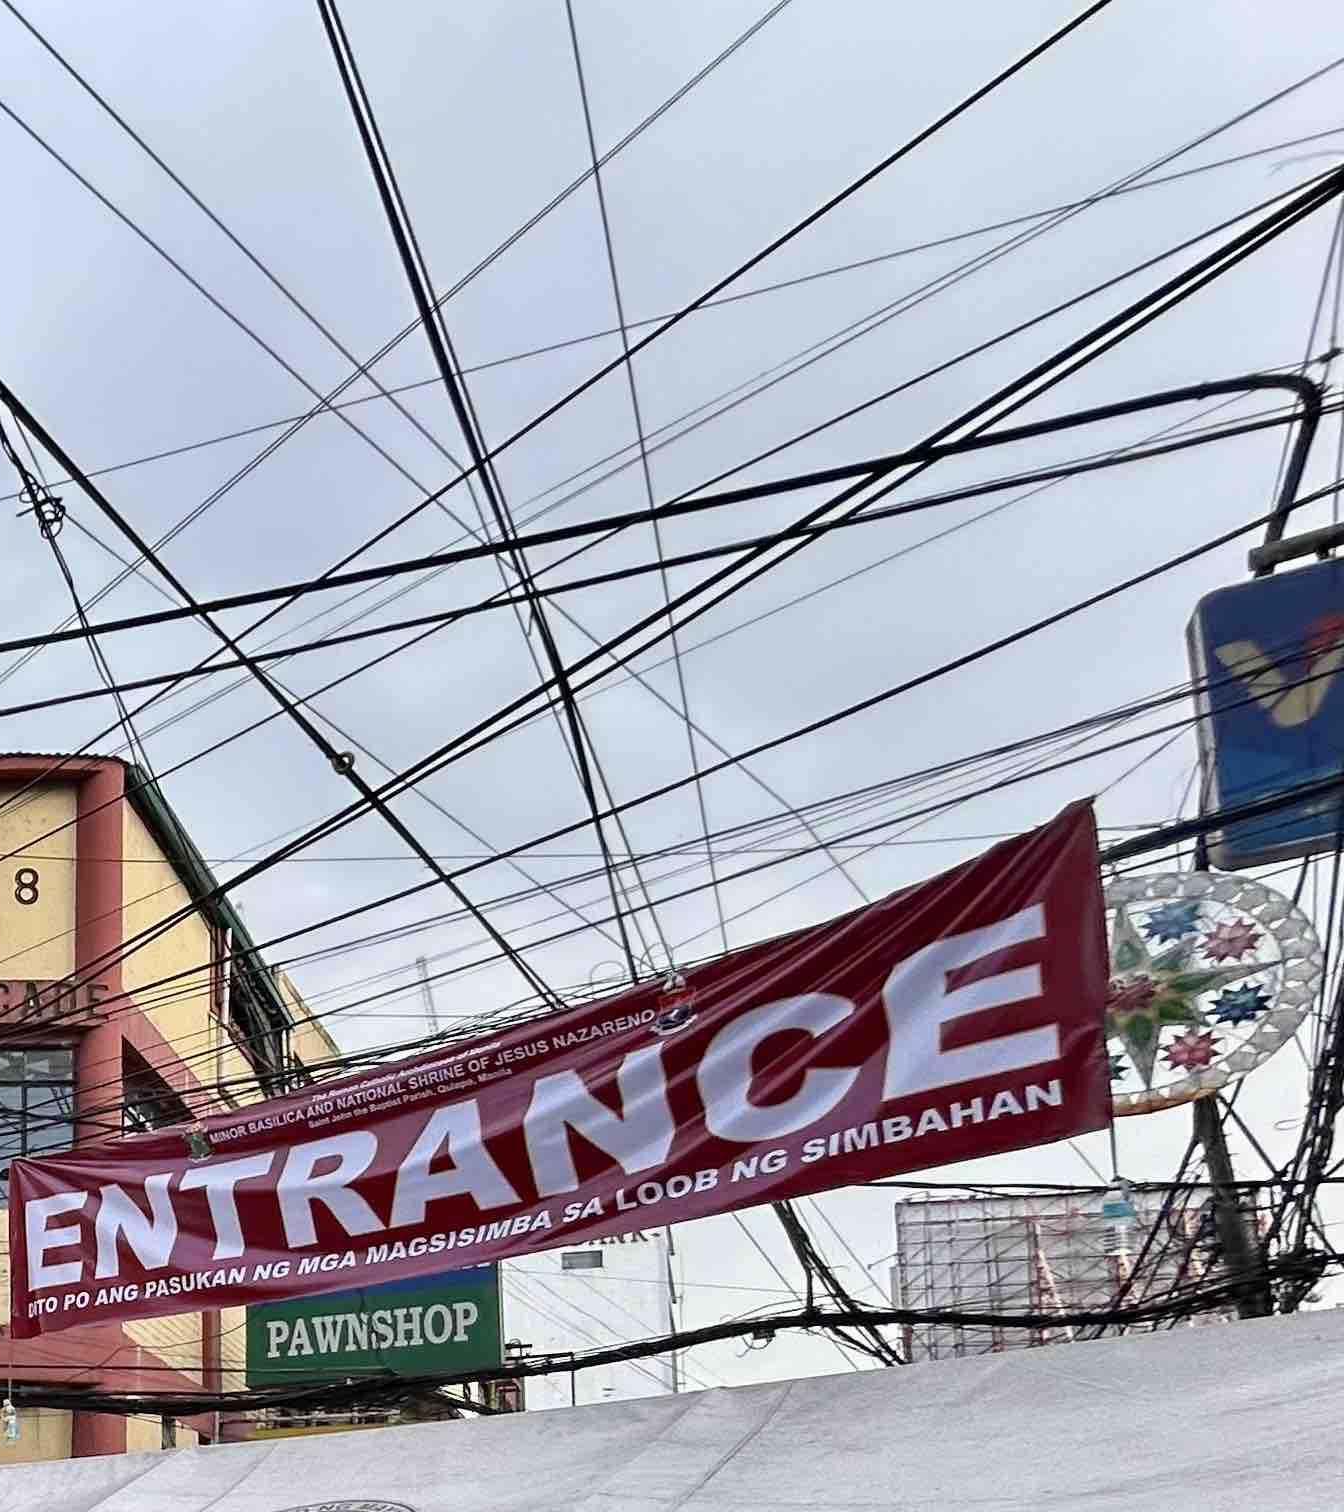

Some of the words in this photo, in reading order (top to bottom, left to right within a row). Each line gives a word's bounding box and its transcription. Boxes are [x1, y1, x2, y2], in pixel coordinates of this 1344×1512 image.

[27, 902, 1061, 1291] ENTRANCE
[209, 1127, 248, 1145] MINOR
[248, 1111, 306, 1134] BASILICA
[305, 1101, 334, 1121] AND
[335, 1083, 406, 1110] NATIONAL
[408, 1065, 466, 1091] SHRINE
[468, 1052, 490, 1073] OF
[494, 1040, 550, 1067] JESUS
[551, 1008, 656, 1050] NAZARENO
[62, 1289, 90, 1310] PO
[95, 1282, 140, 1308] ANG
[144, 1264, 246, 1300] PASUKAN
[252, 1260, 291, 1282] NG
[297, 1250, 358, 1277] MGA
[365, 1209, 553, 1267] MAGSISIMBA
[562, 1198, 606, 1224] SA
[614, 1165, 721, 1213] LOOB
[730, 1147, 788, 1185] NG
[798, 1079, 1064, 1164] SIMBAHAN
[265, 1301, 479, 1360] PAWNSHOP
